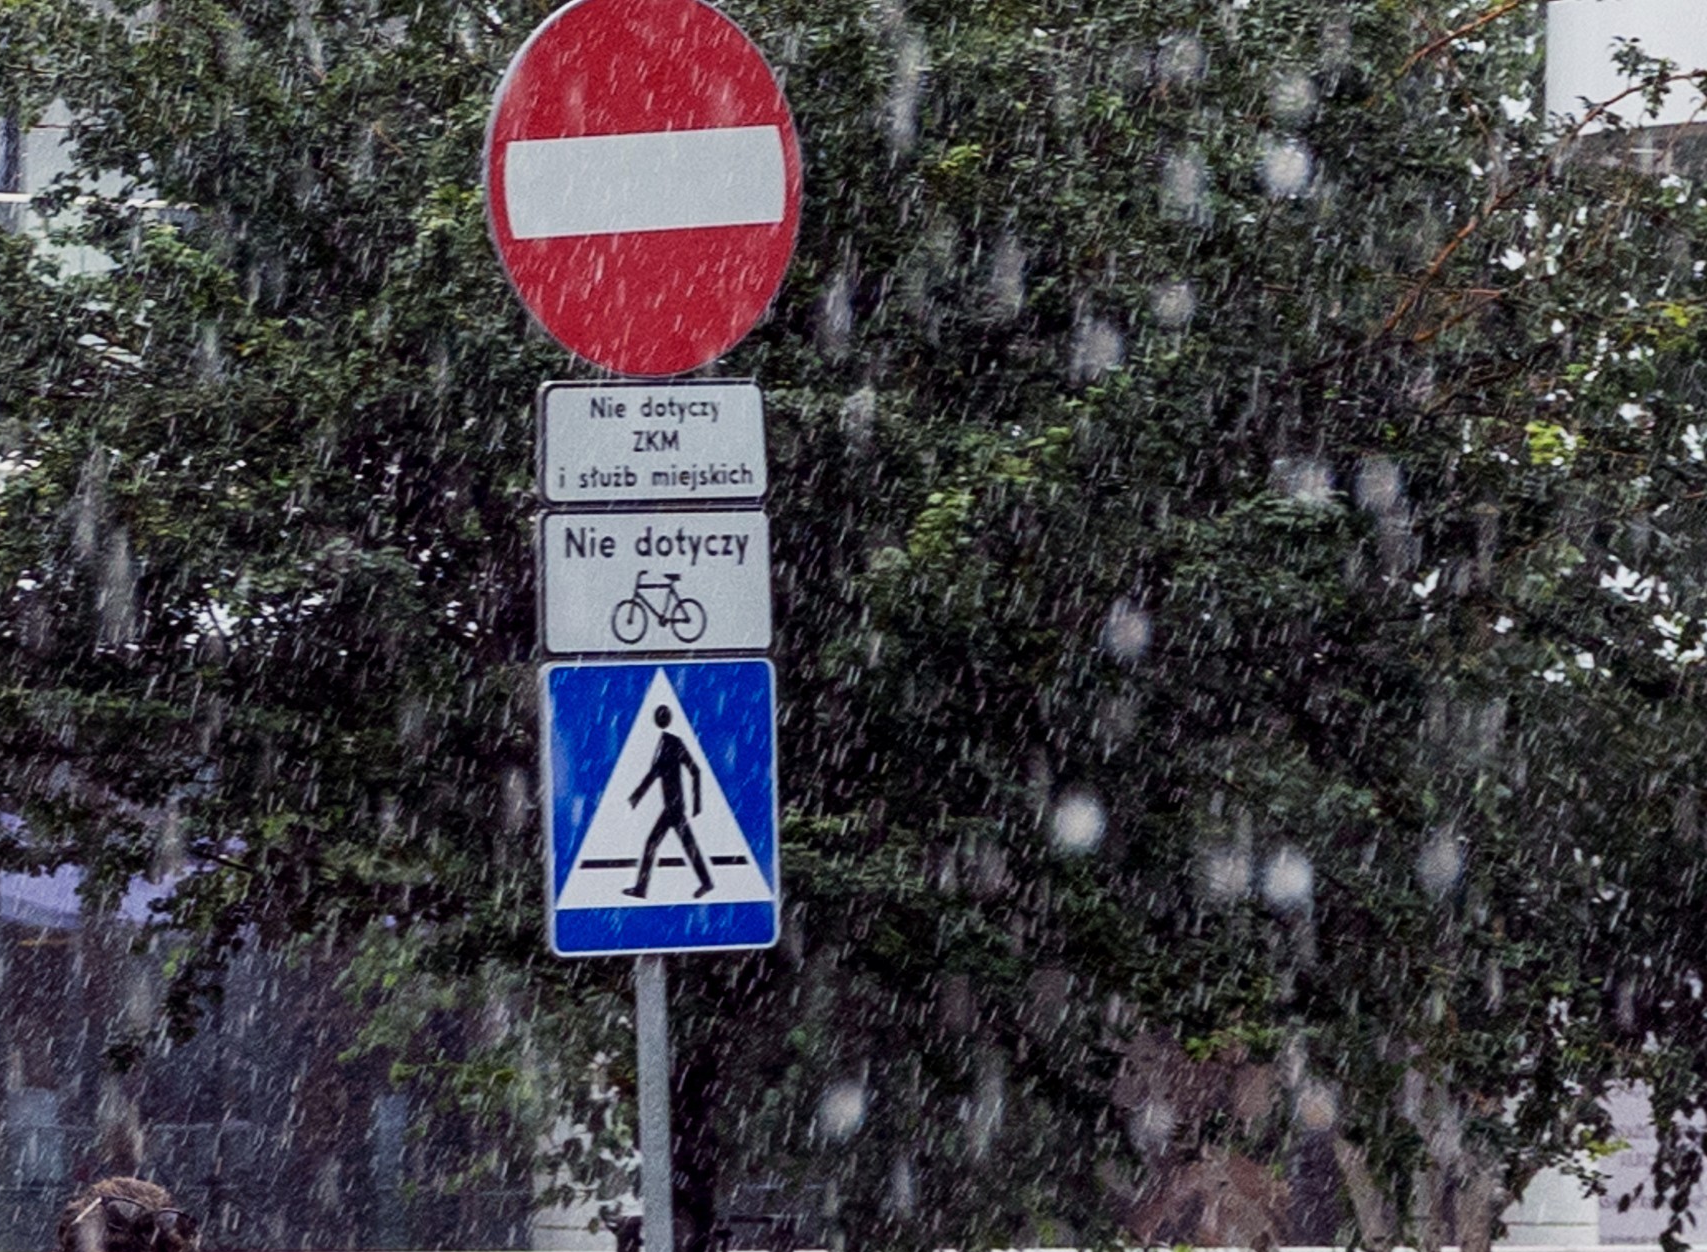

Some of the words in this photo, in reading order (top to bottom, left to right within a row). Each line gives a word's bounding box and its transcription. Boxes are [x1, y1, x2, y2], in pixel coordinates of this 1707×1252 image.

[590, 397, 626, 418] Nie
[640, 396, 720, 424] dotyczy
[633, 430, 680, 452] ZKM
[559, 468, 565, 488] i
[579, 466, 637, 488] służb
[652, 465, 754, 491] miejskich
[565, 527, 616, 558] Nie
[635, 526, 749, 566] dotyczy
